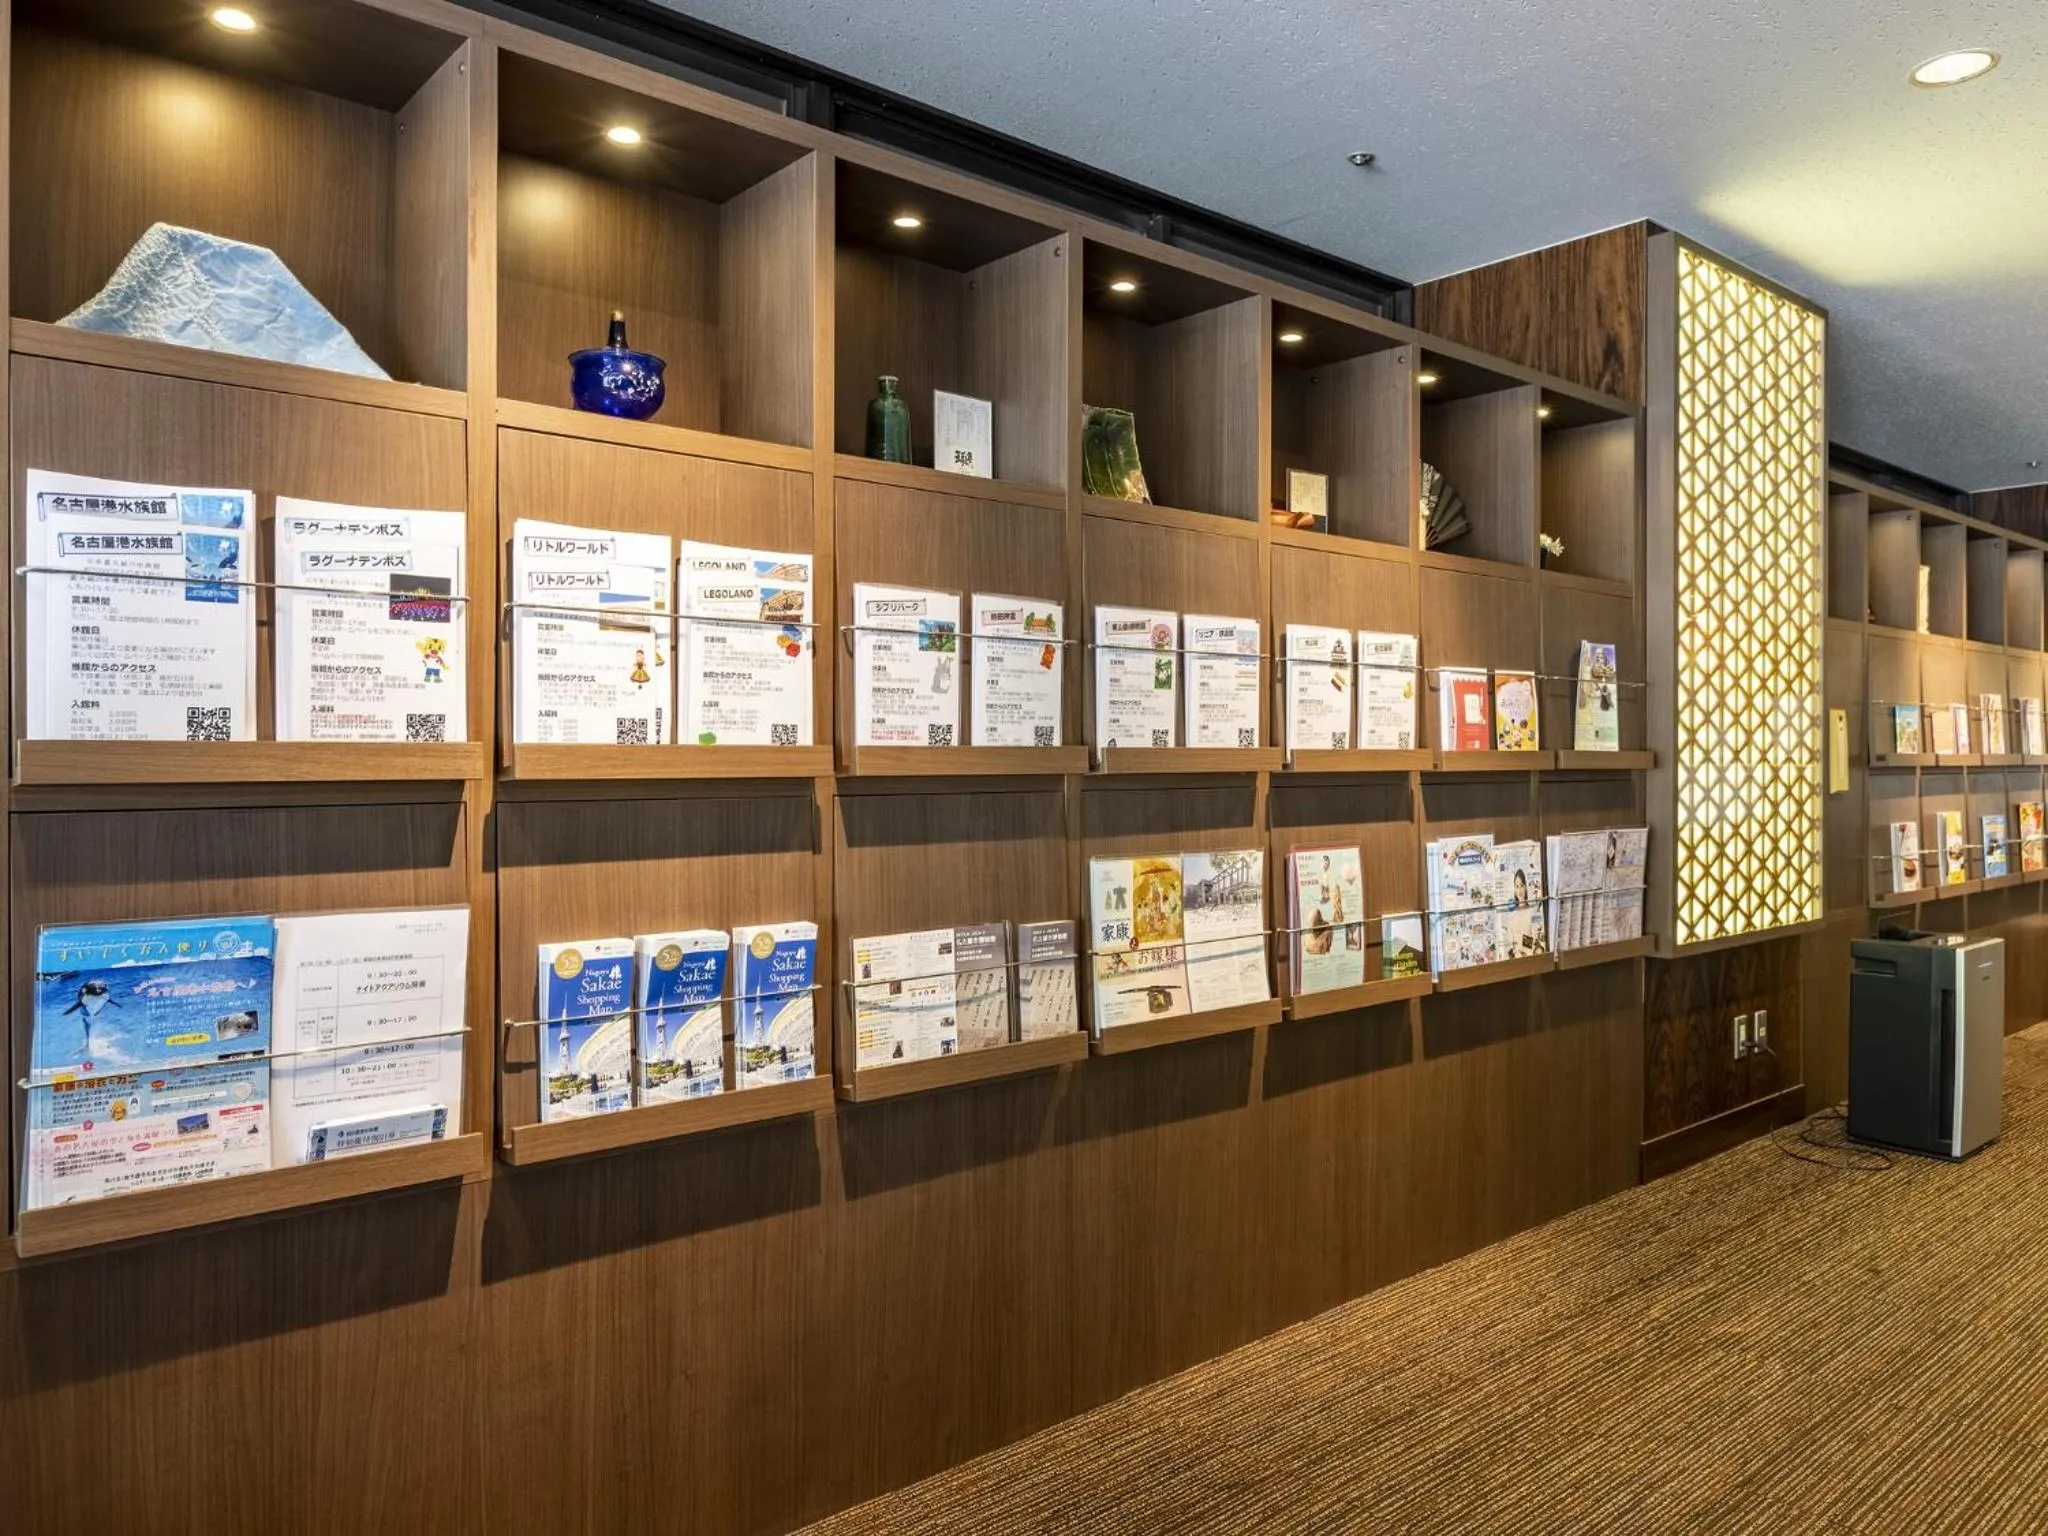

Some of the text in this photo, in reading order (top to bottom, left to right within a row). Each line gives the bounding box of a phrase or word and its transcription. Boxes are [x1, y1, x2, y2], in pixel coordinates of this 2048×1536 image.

[70, 536, 173, 550] 名古屋港水族館
[533, 541, 609, 554] リトルワールド
[309, 554, 407, 567] ラグーナテンボス
[536, 575, 605, 586] リトルワールド
[71, 595, 110, 606] 営業時間
[704, 589, 754, 599] LEGOLAND
[876, 602, 919, 612] ジブリパーク
[71, 626, 100, 635] 休館日
[71, 663, 157, 673] 当館からのアクセス
[71, 700, 100, 709] 入館料
[1101, 922, 1130, 942] 家康
[771, 958, 806, 971] Sakae
[679, 968, 716, 982] Sakae
[581, 977, 622, 993] Sakae
[577, 993, 621, 1006] Shopping
